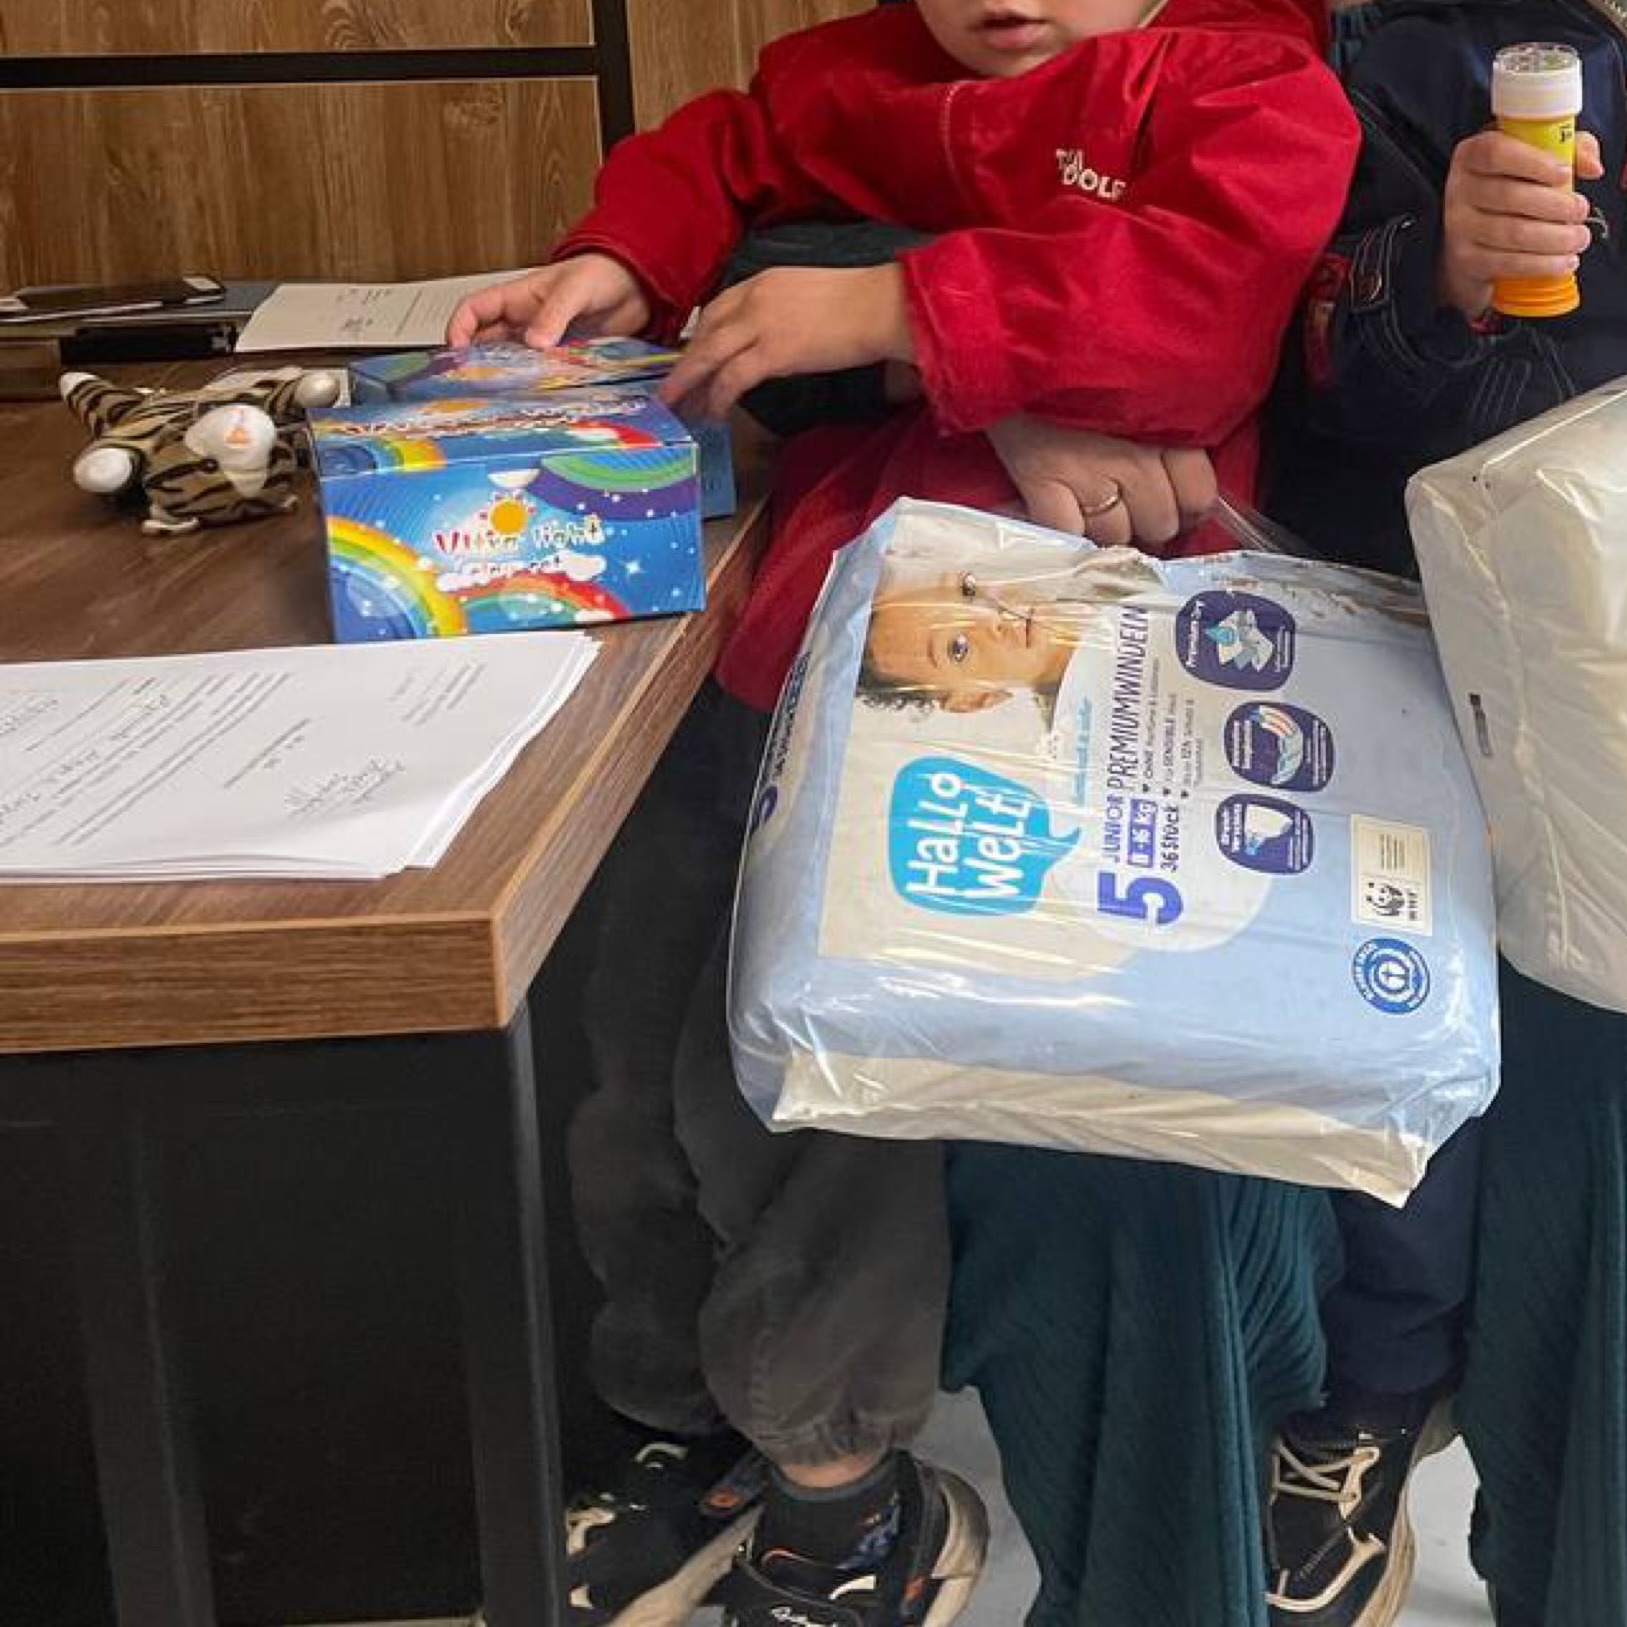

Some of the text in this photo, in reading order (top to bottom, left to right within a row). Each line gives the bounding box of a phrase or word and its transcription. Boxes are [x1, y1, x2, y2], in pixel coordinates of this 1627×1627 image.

[1107, 604, 1149, 789] PREMIUMWINDELN
[905, 772, 969, 896] Hallo
[962, 793, 1032, 897] Welt
[1097, 871, 1184, 925] 5
